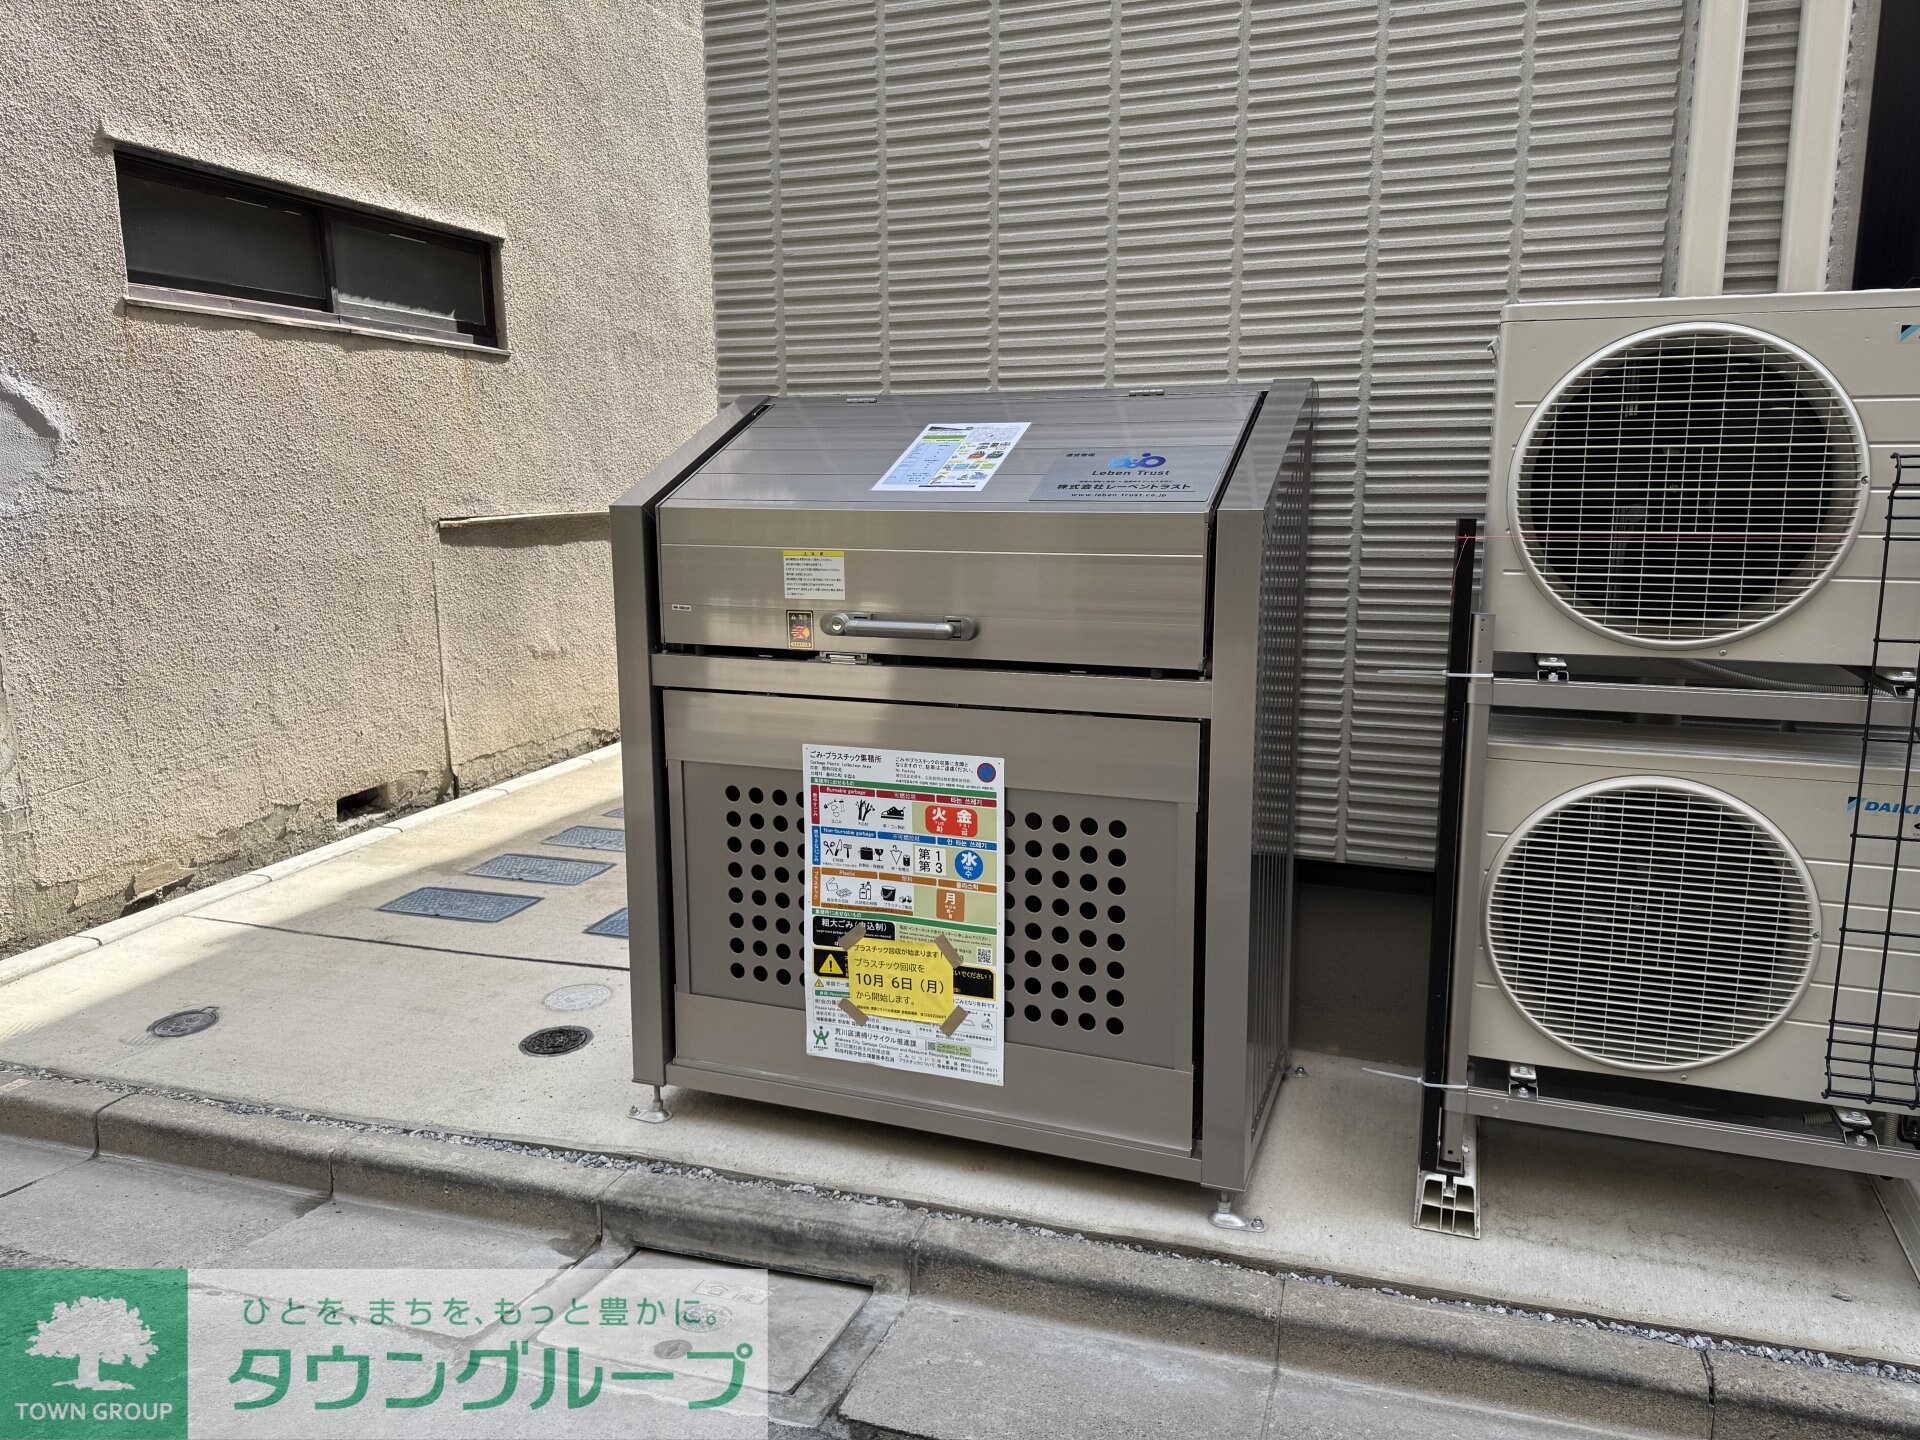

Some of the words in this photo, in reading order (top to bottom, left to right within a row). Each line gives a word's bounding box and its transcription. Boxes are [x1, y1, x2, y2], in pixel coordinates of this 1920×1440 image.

[932, 807, 948, 822] 火
[956, 809, 972, 825] 金
[960, 851, 977, 867] 水
[945, 892, 956, 905] 月
[853, 945, 943, 959] プラスチック回収が始まります！
[854, 958, 925, 973] プラスチック回収を
[855, 972, 884, 988] 10月
[856, 990, 915, 1006] から開始します。
[953, 997, 998, 1010] ごみとなり有料です。
